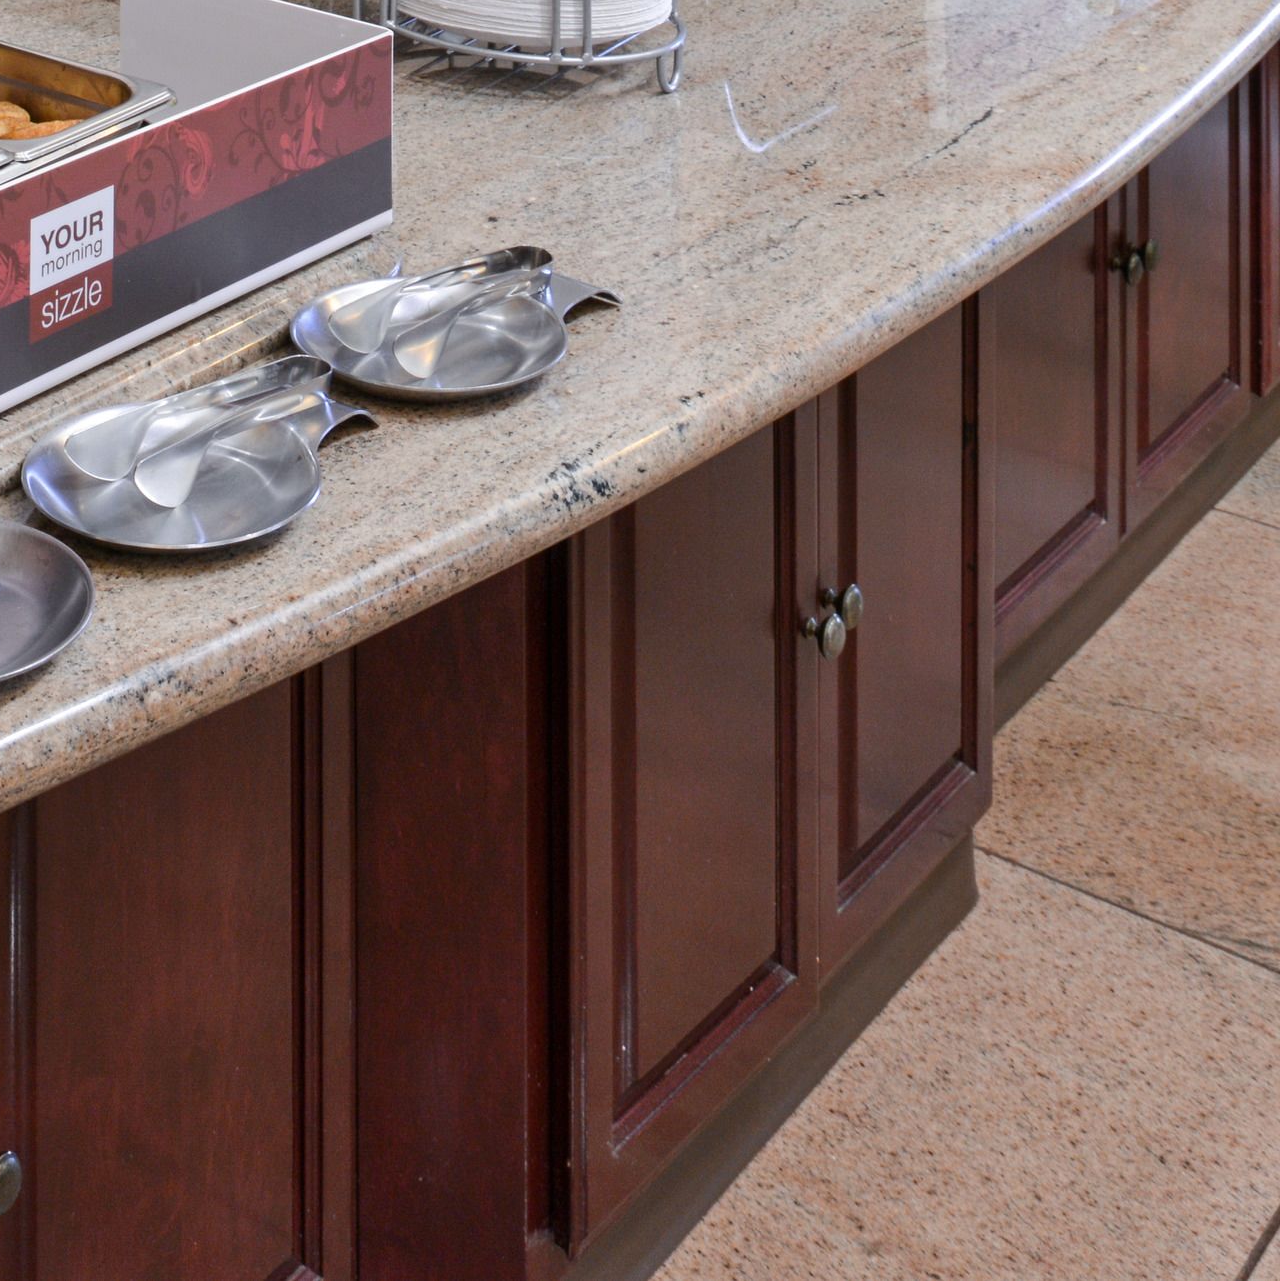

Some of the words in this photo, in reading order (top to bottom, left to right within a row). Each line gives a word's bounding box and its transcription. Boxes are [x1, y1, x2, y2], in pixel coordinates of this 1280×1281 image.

[40, 209, 104, 255] YOUR
[41, 238, 103, 277] morning
[41, 276, 103, 329] sizzle
